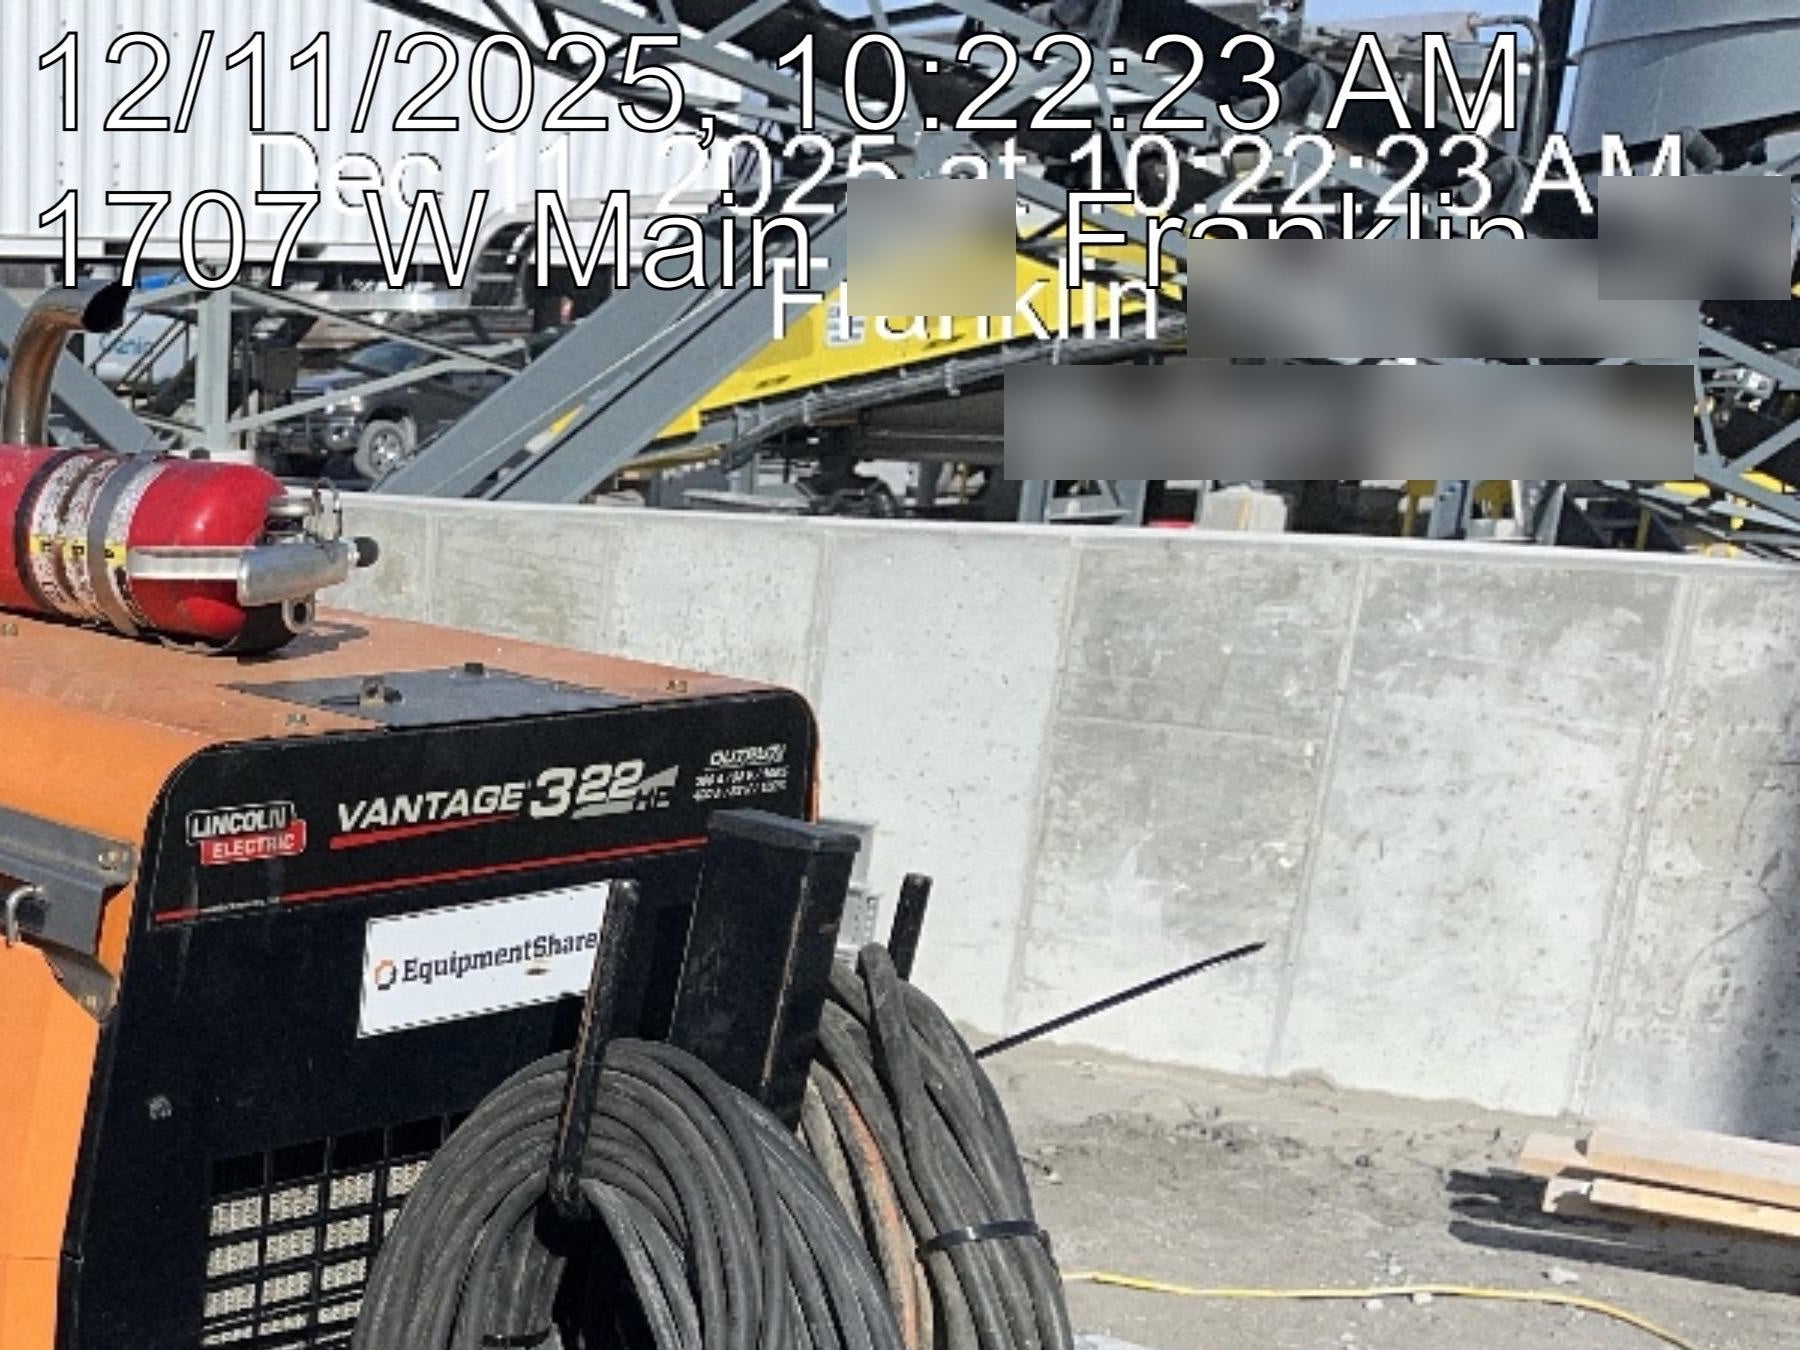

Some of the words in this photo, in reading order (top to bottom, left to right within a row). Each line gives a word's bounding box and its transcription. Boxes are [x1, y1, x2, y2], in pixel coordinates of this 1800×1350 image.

[338, 782, 526, 833] VANTAGE
[530, 758, 645, 820] 322
[191, 805, 287, 838] LINCOLN
[212, 832, 296, 859] ELECTRIC
[402, 931, 598, 984] EquipmentShare
